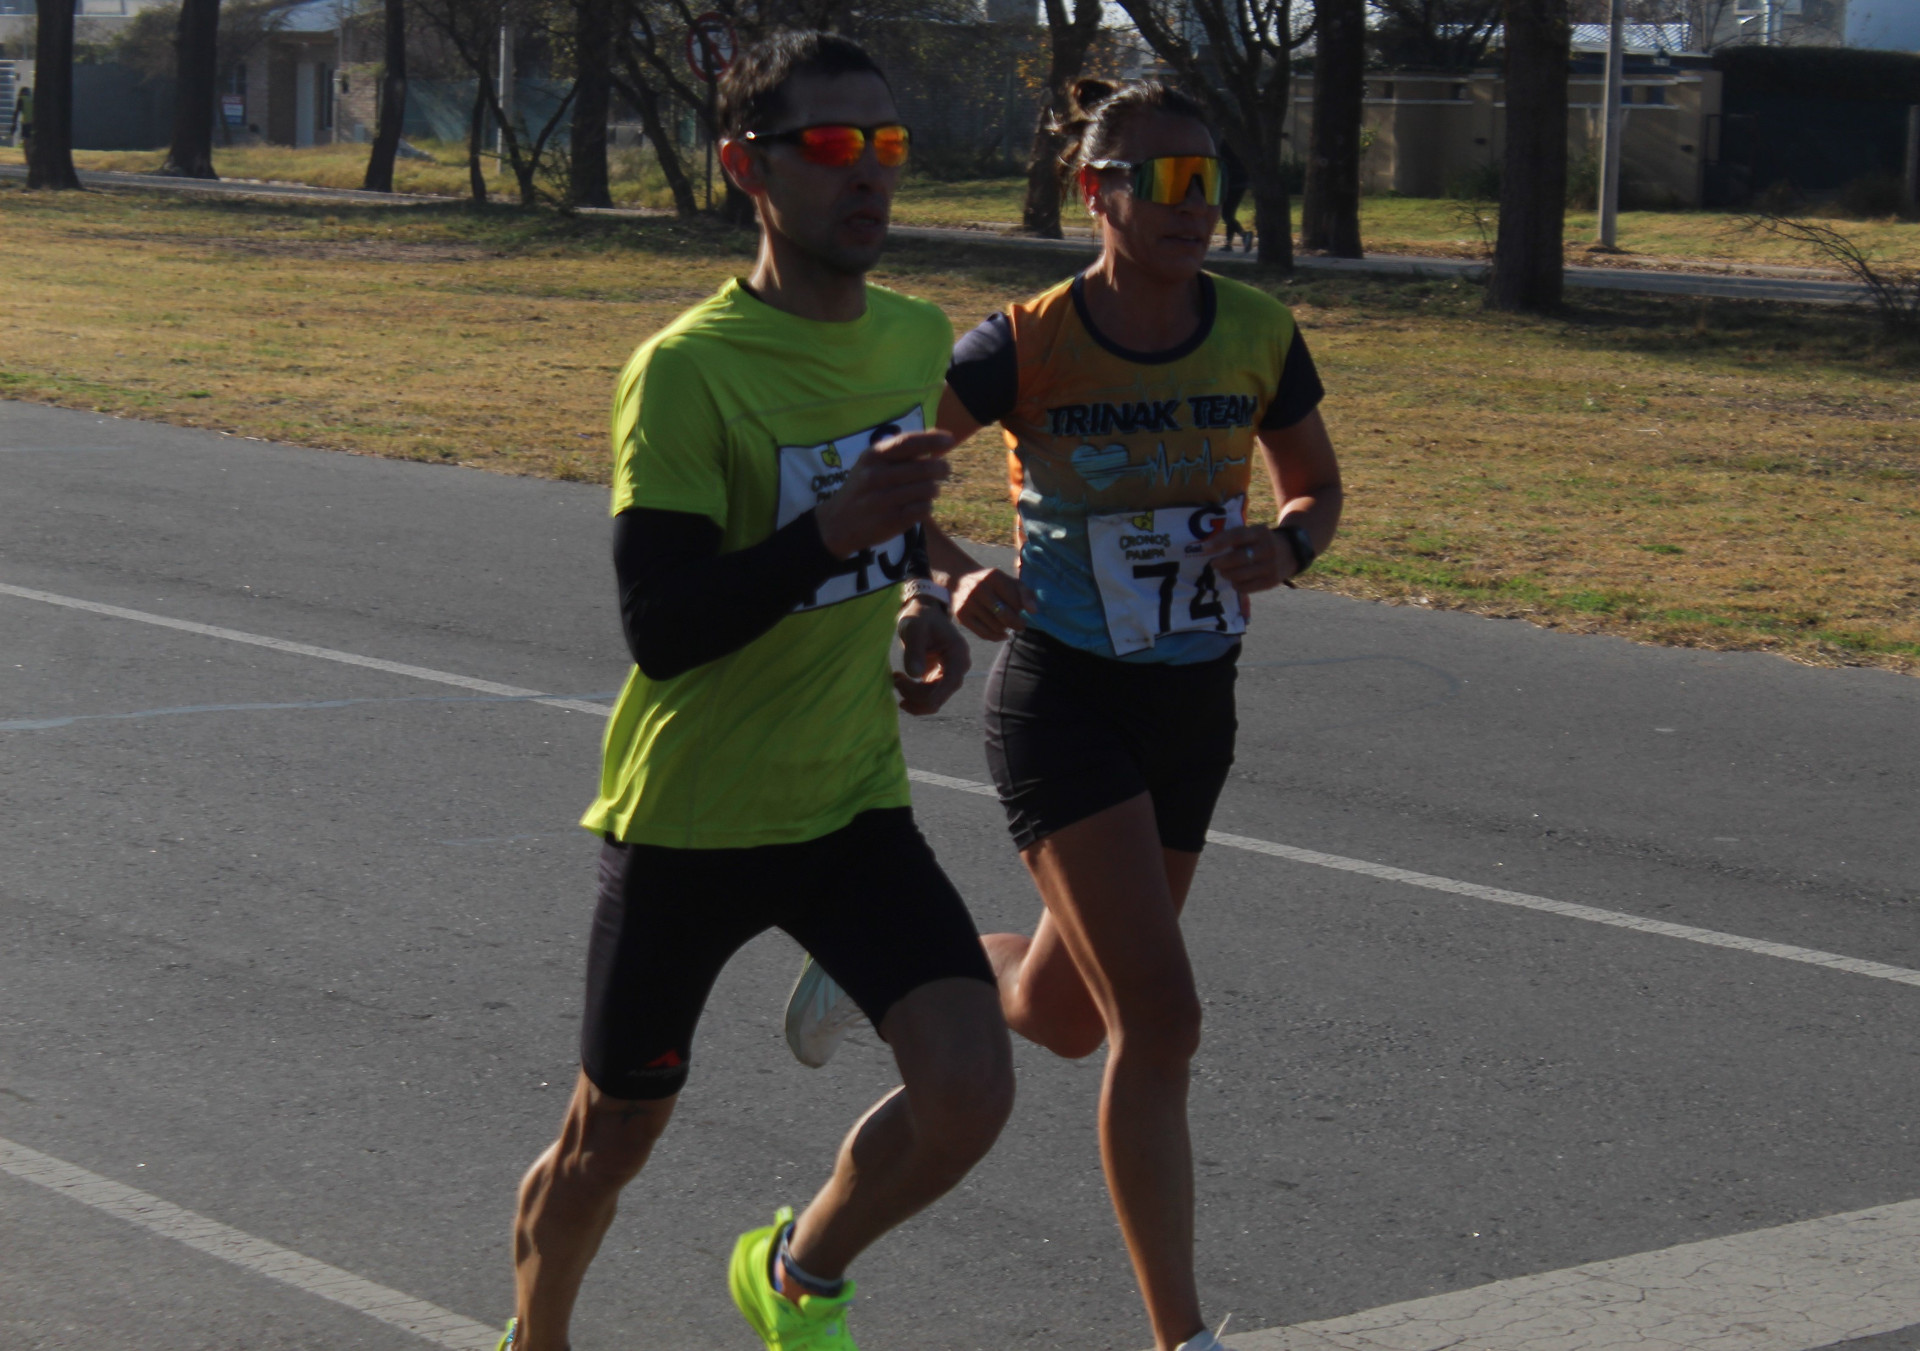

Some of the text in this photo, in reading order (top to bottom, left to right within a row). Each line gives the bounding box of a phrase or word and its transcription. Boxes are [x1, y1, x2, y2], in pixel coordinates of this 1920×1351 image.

[1047, 395, 1259, 436] TRINAK TEAM
[1119, 533, 1171, 548] CRONOS
[1125, 547, 1166, 561] PAMPA
[1132, 561, 1228, 633] 74
